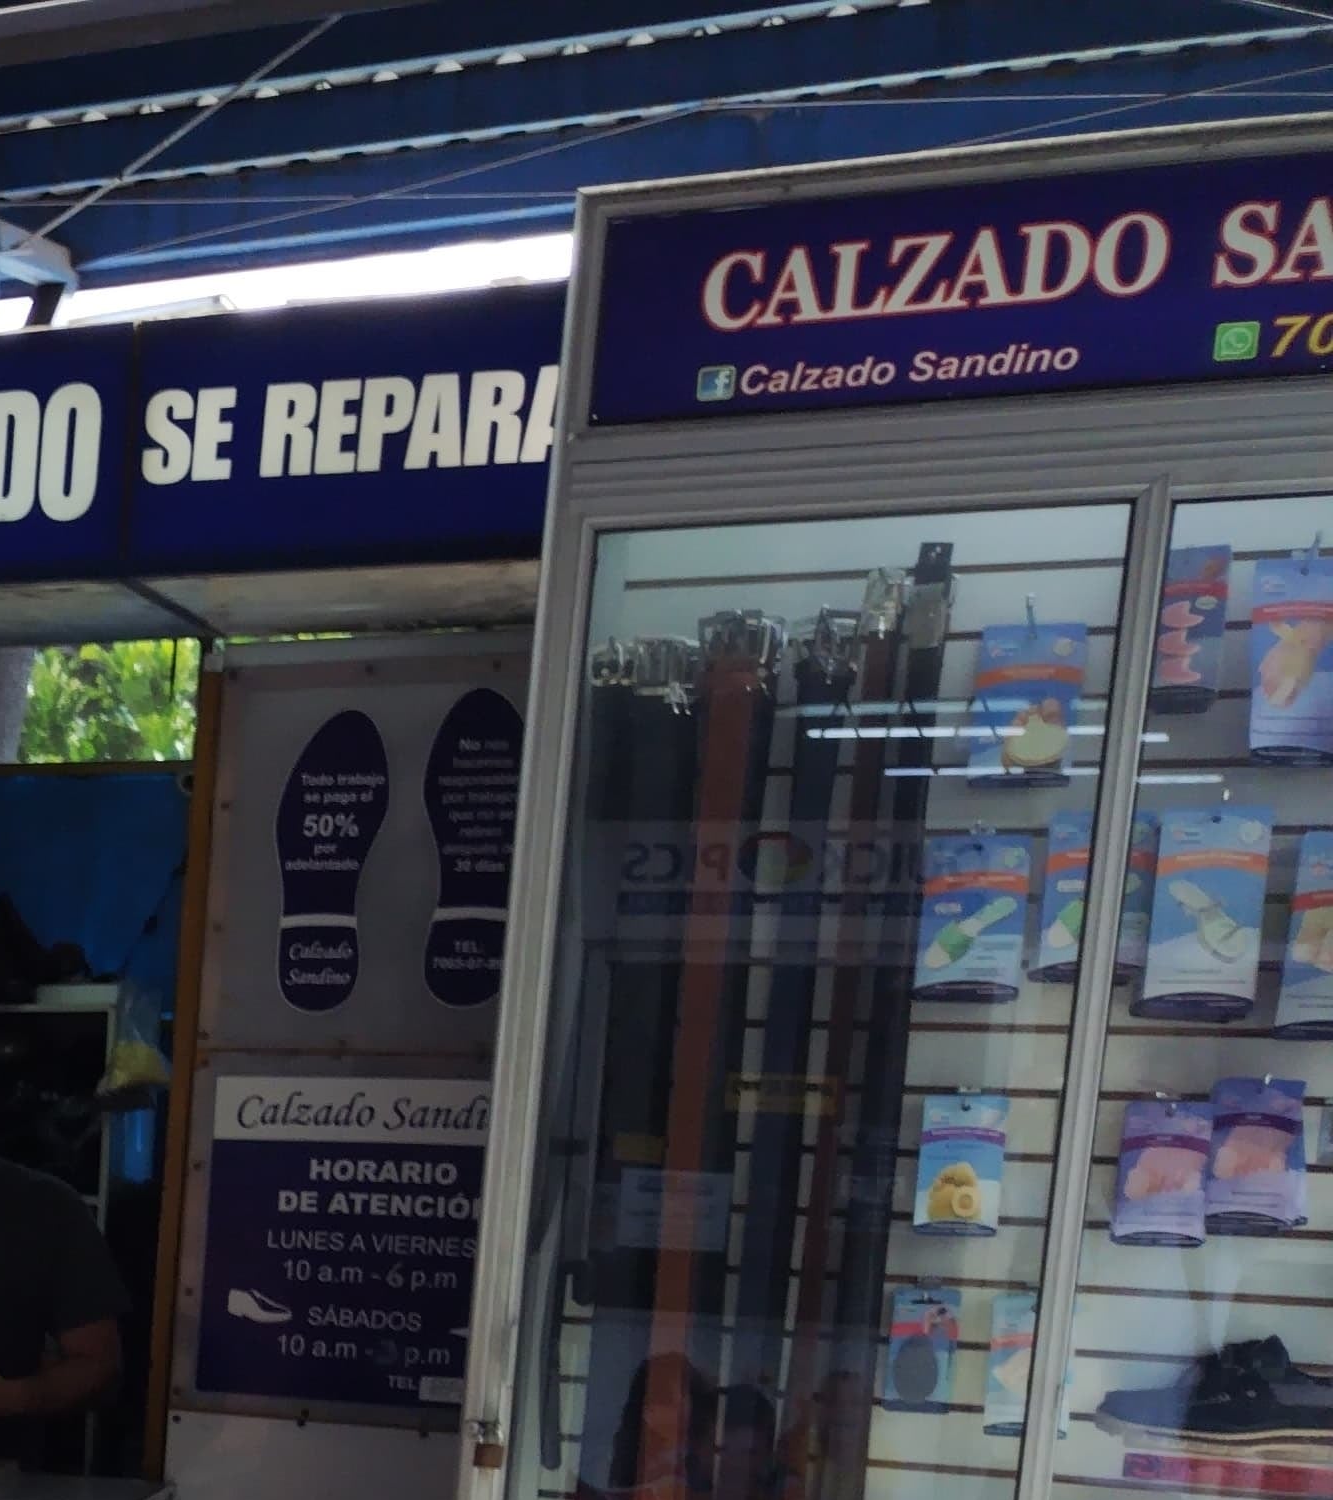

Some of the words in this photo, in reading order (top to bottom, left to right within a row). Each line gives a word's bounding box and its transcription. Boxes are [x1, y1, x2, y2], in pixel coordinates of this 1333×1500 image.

[700, 210, 1171, 332] CALZADO
[739, 357, 896, 396] Calzado
[908, 342, 1080, 382] Sandino
[142, 387, 237, 486] SE
[300, 772, 335, 786] Todo
[336, 772, 386, 788] trabajo
[303, 792, 322, 803] se
[360, 788, 374, 803] el
[302, 813, 360, 838] 50%
[288, 939, 354, 961] Calzado
[285, 967, 353, 987] Sandino
[237, 1092, 376, 1129] Calzado
[308, 1158, 458, 1186] HORARIO
[277, 1190, 318, 1213] DE
[266, 1229, 346, 1252] LUNES
[348, 1232, 366, 1253] A
[371, 1233, 477, 1258] VIERNES
[282, 1259, 310, 1281] 10
[316, 1263, 363, 1283] a.m
[385, 1260, 405, 1288] 6
[409, 1268, 458, 1293] p.m
[307, 1302, 423, 1333] SÁBADOS
[277, 1334, 305, 1358] 10
[311, 1338, 358, 1360] a.m
[400, 1344, 451, 1367] p.m
